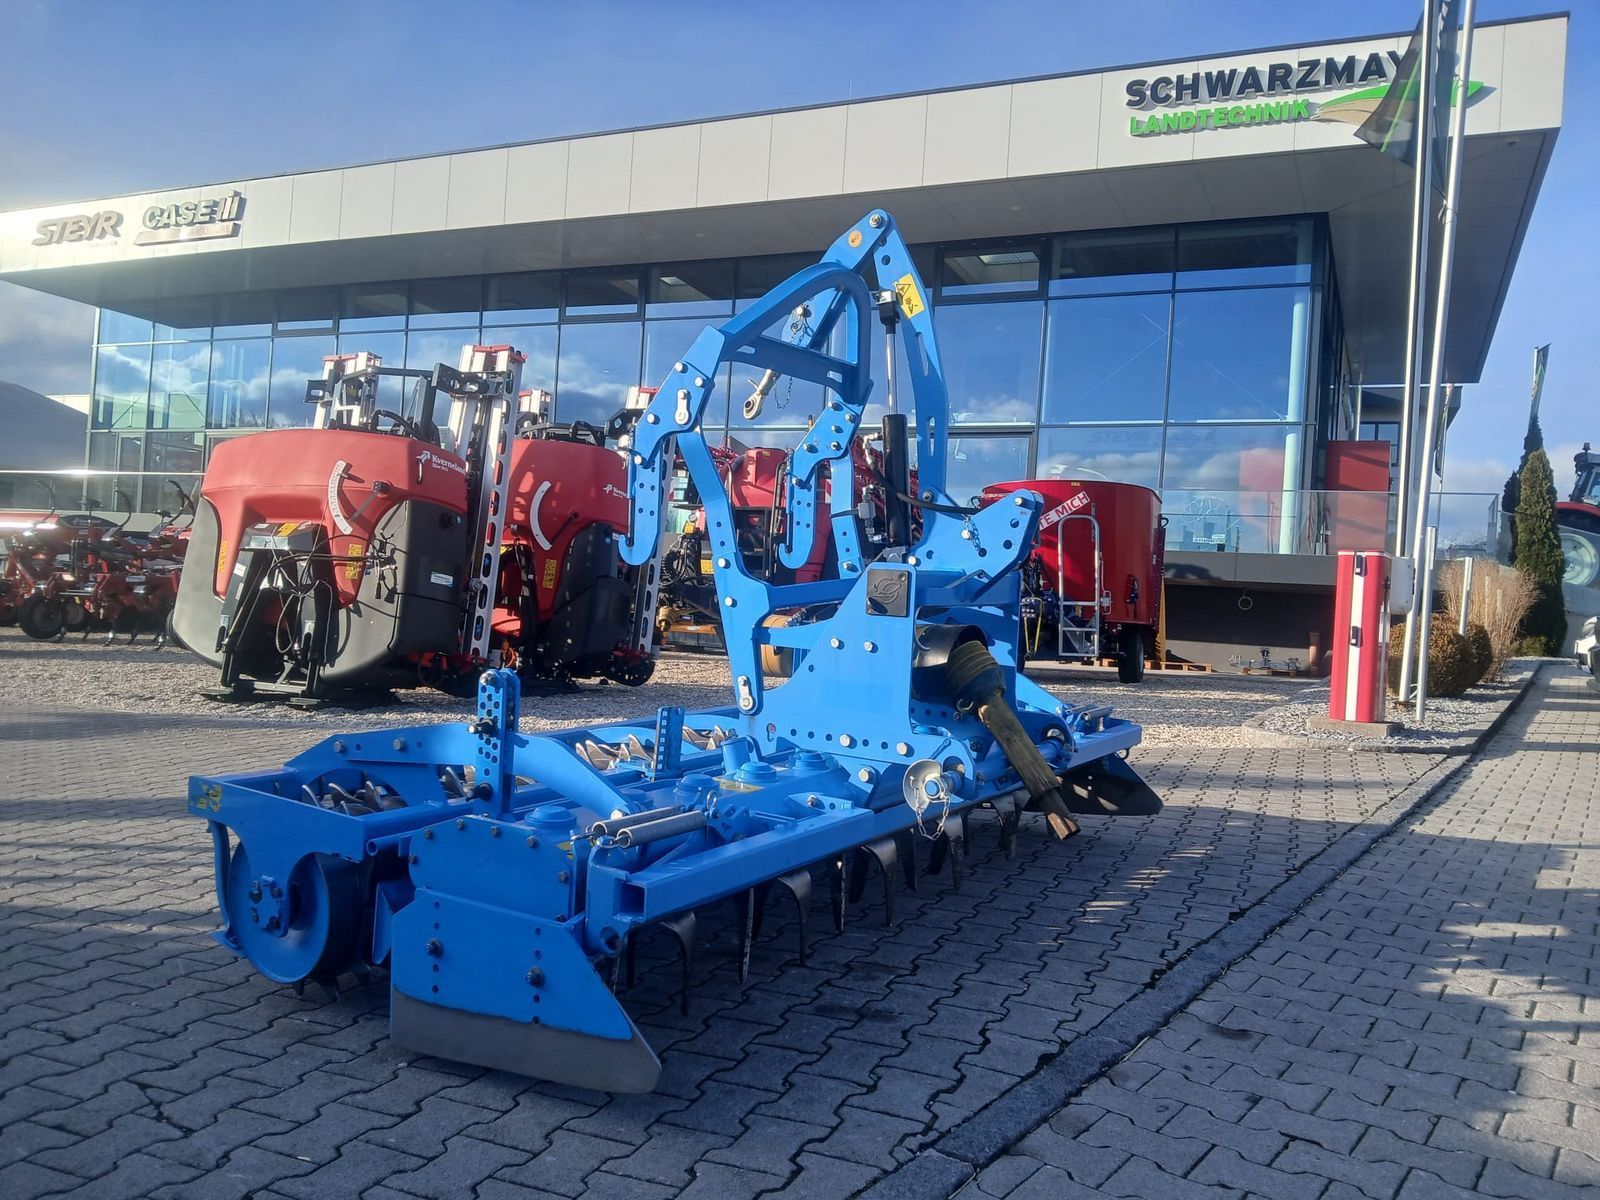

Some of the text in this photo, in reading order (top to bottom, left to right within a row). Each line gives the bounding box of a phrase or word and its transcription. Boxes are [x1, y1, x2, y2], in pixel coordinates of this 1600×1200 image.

[1130, 99, 1310, 136] LANDTECHNIK
[32, 211, 123, 246] STEYR
[143, 199, 217, 230] CASE
[1055, 492, 1089, 519] MICH
